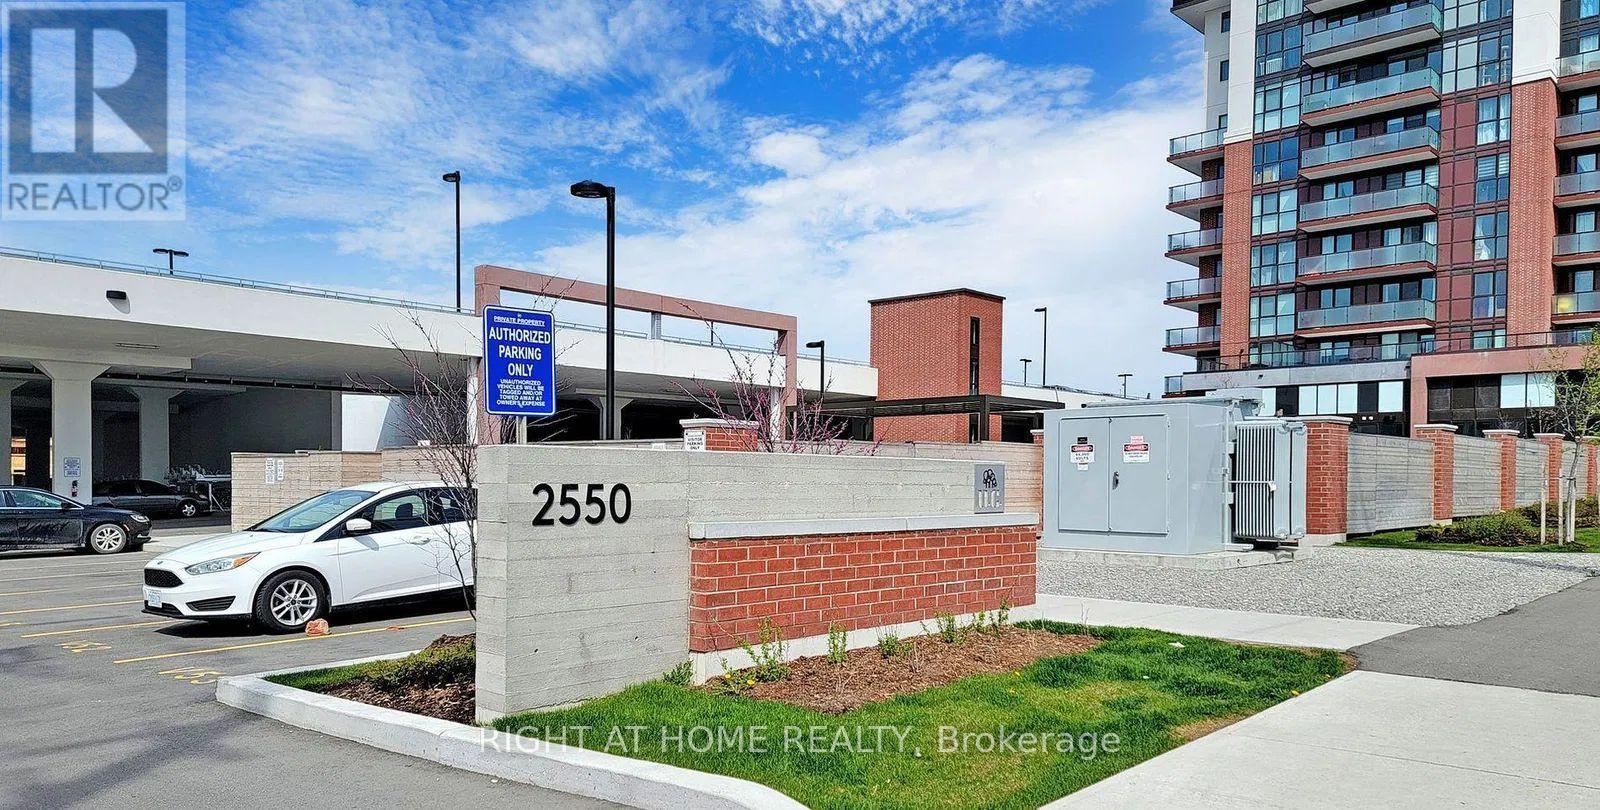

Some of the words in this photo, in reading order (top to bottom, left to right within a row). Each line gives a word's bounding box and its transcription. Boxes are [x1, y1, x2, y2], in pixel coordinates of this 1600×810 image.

[493, 315, 516, 323] PRIVATE
[517, 318, 545, 327] PROPERTY
[489, 326, 551, 344] AUTHORIZED
[498, 344, 542, 360] PARKING
[507, 363, 534, 377] ONLY
[497, 383, 523, 391] VEHICLES
[532, 483, 631, 526] 2550
